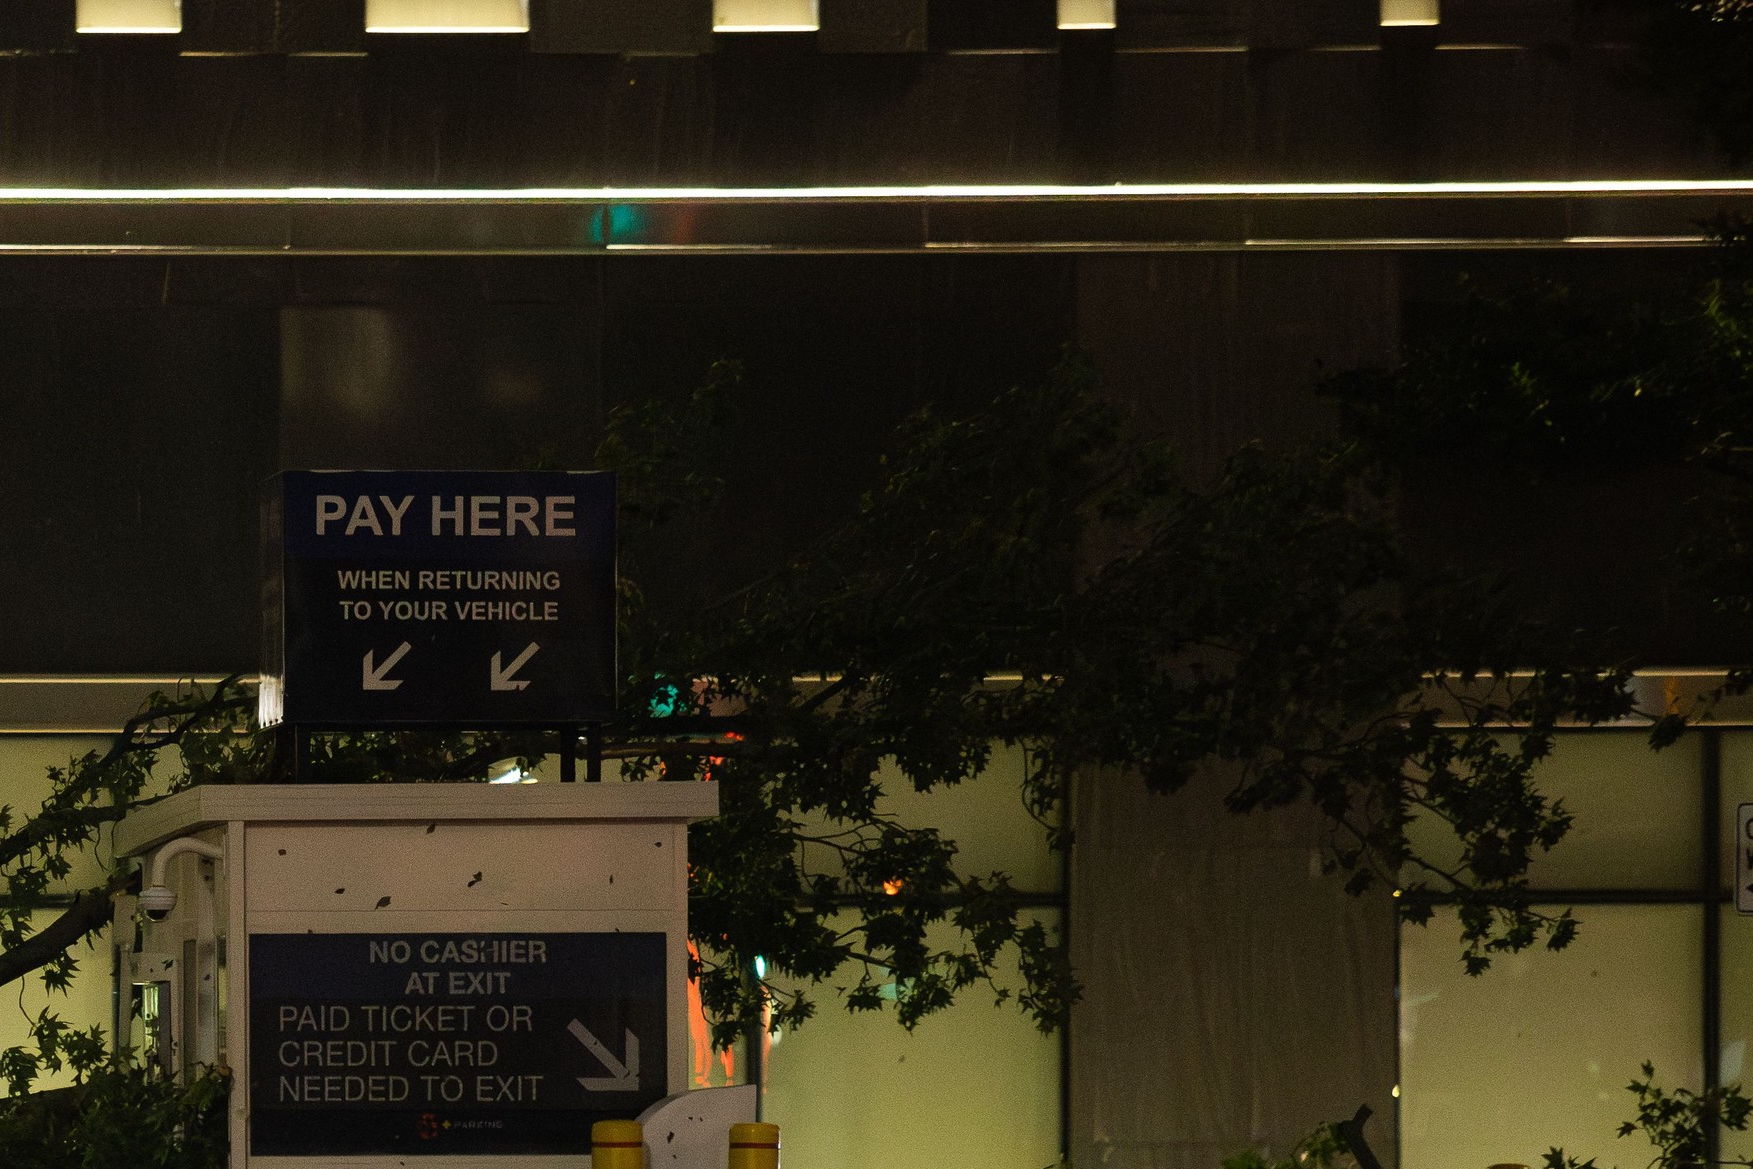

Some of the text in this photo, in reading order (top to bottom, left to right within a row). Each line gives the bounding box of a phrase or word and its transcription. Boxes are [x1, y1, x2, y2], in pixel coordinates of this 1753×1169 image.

[316, 495, 576, 537] PAY HERE
[337, 570, 561, 591] WHEN RETURNING
[339, 600, 559, 621] TO YOUR VEHICLE
[369, 940, 547, 964] NO CASHIER
[404, 971, 512, 995] AT EXIT
[279, 1005, 533, 1032] PAID TICKET OR
[279, 1041, 498, 1067] CREDIT CARD
[279, 1075, 544, 1102] NEEDED TO EXIT
[453, 1120, 503, 1129] PARKING
